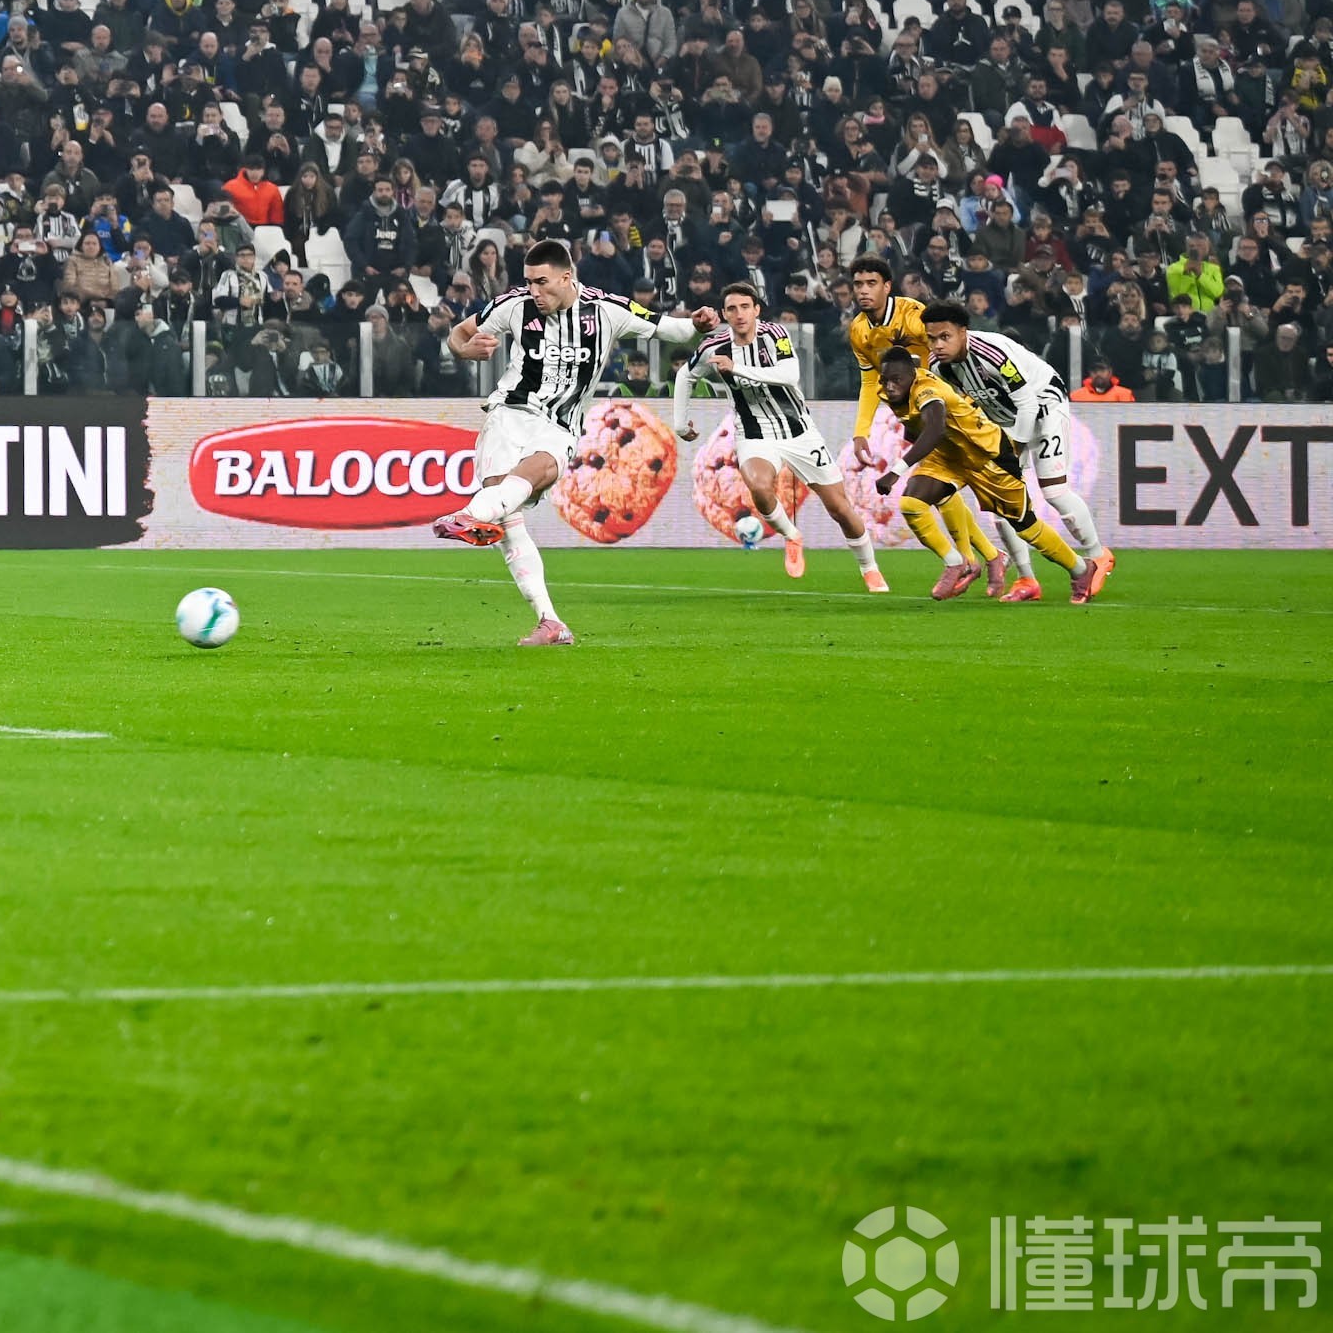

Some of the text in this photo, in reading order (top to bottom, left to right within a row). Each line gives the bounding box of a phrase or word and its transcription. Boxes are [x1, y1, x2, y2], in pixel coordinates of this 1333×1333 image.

[528, 338, 591, 366] Jeep
[963, 386, 999, 401] eep
[1039, 435, 1063, 459] 22
[212, 449, 482, 496] BALOCCO
[1117, 424, 1333, 527] EXT
